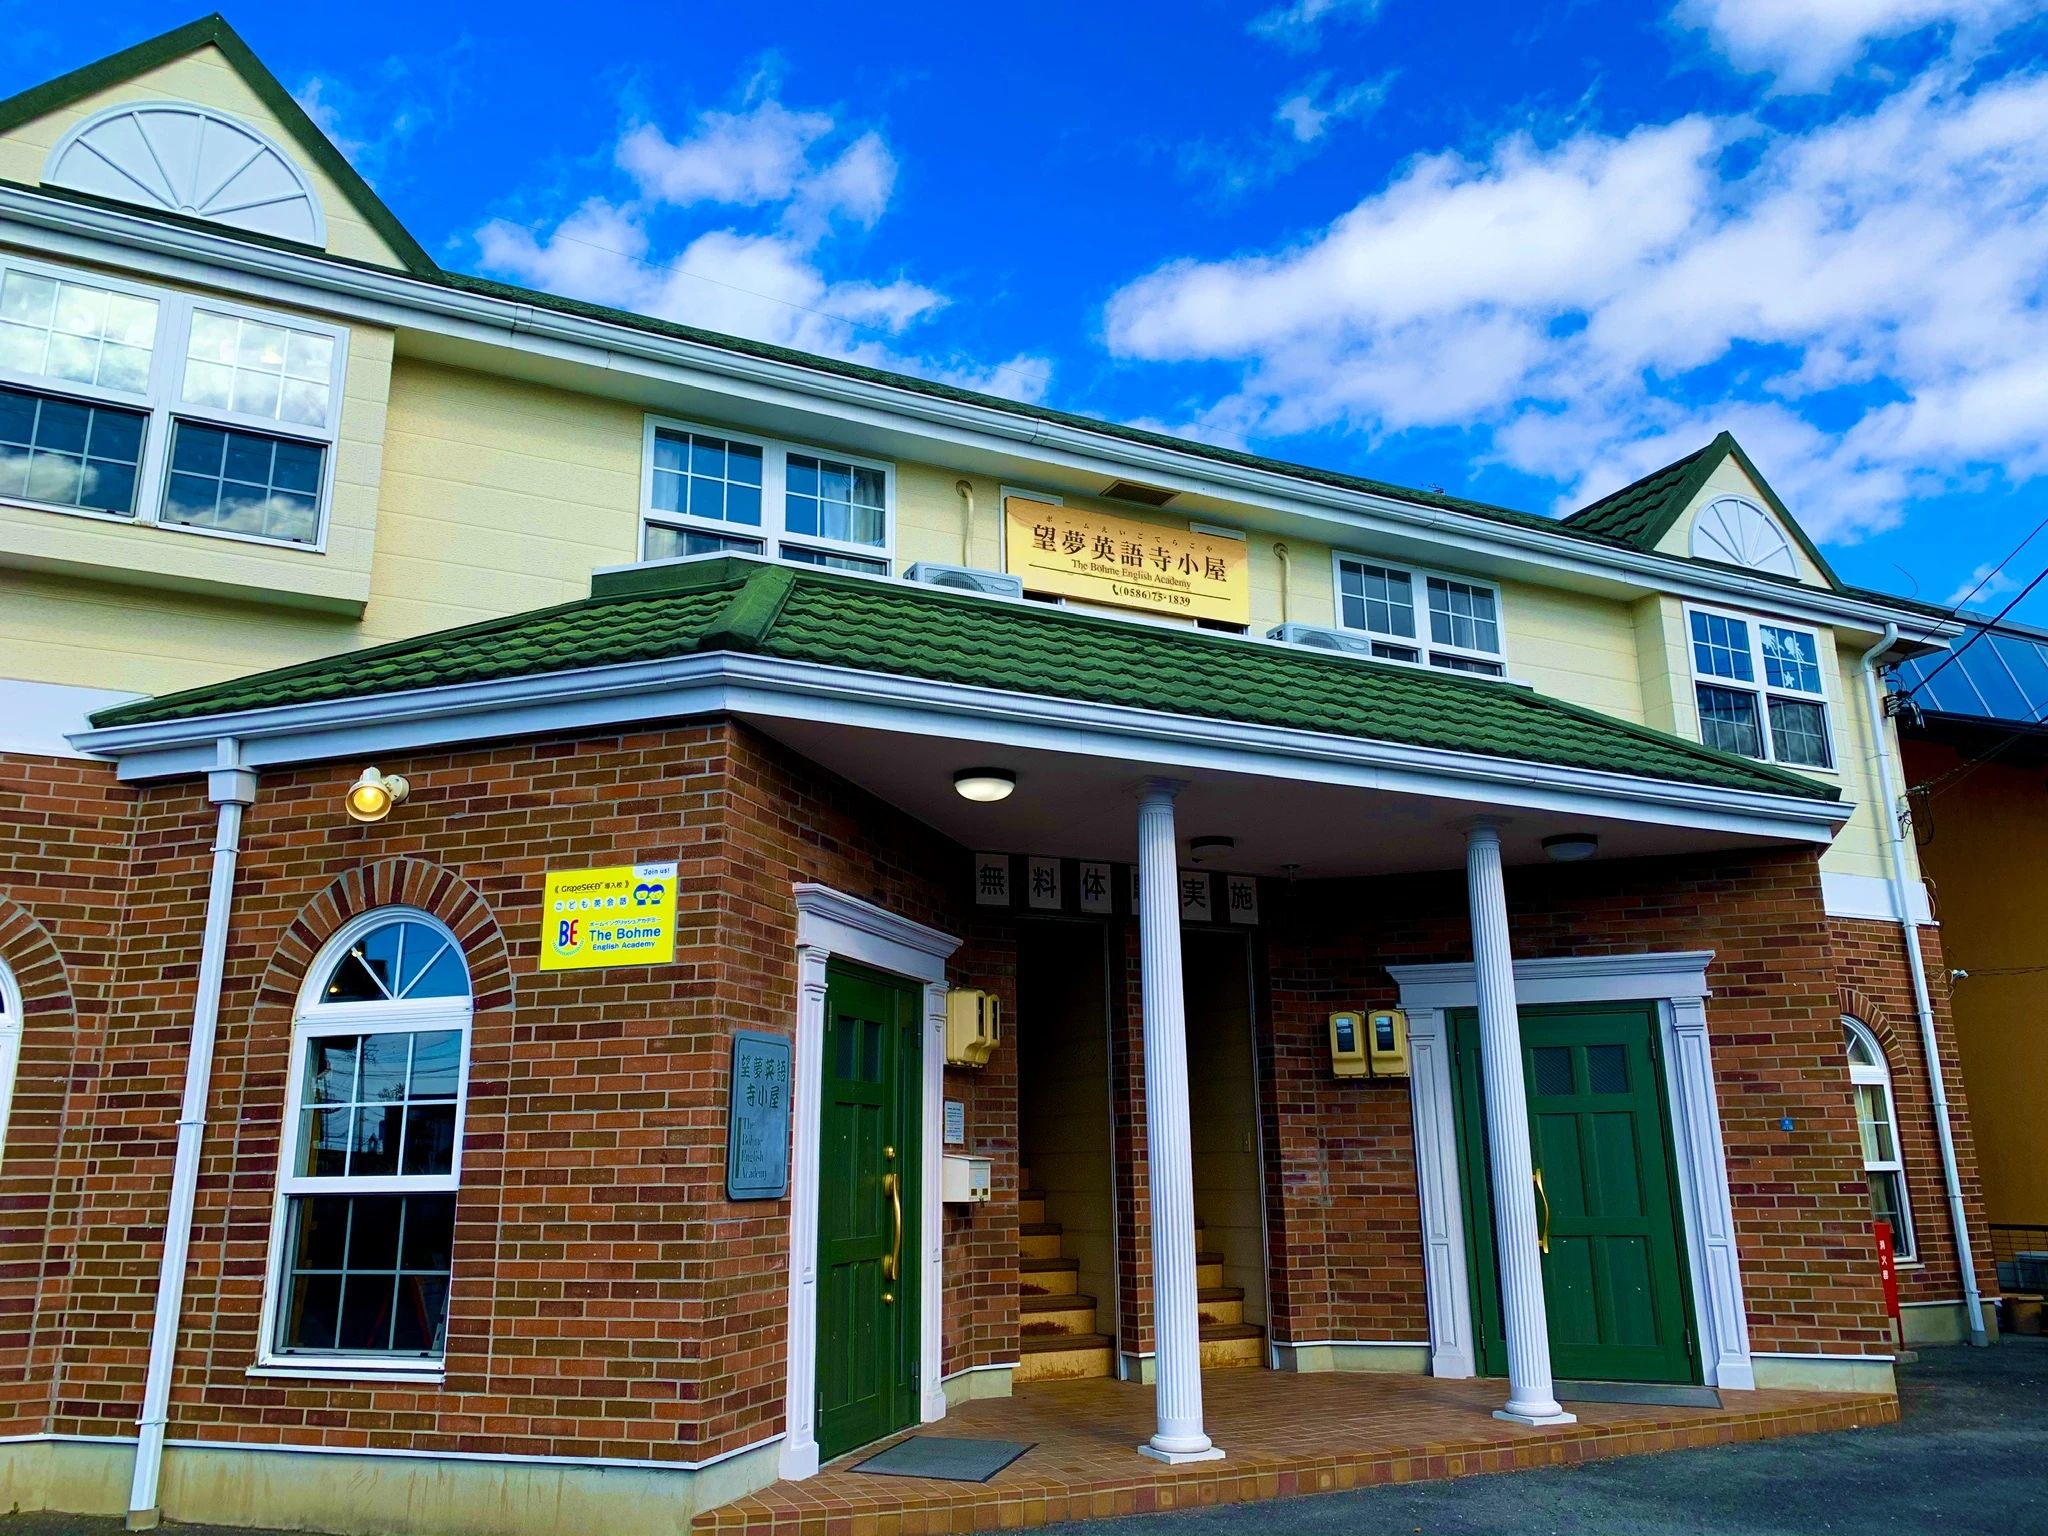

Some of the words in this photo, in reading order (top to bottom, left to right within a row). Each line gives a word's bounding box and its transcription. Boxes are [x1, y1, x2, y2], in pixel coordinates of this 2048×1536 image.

[1032, 524, 1227, 582] 望夢英語寺小屋
[1072, 559, 1088, 570] The
[1122, 568, 1152, 583] English
[1154, 574, 1191, 589] Academy
[643, 867, 659, 876] Join
[660, 867, 670, 875] us!
[979, 863, 1254, 911] 無料体実施
[555, 896, 627, 911] こども英会話
[558, 919, 579, 947] BE
[589, 930, 612, 942] The
[616, 927, 661, 940] Bohme
[592, 943, 619, 951] English
[621, 941, 656, 949] Academy
[740, 1055, 786, 1082] 望夢英語
[746, 1084, 780, 1109] 寺小屋
[741, 1149, 764, 1163] English
[741, 1166, 768, 1181] Academy
